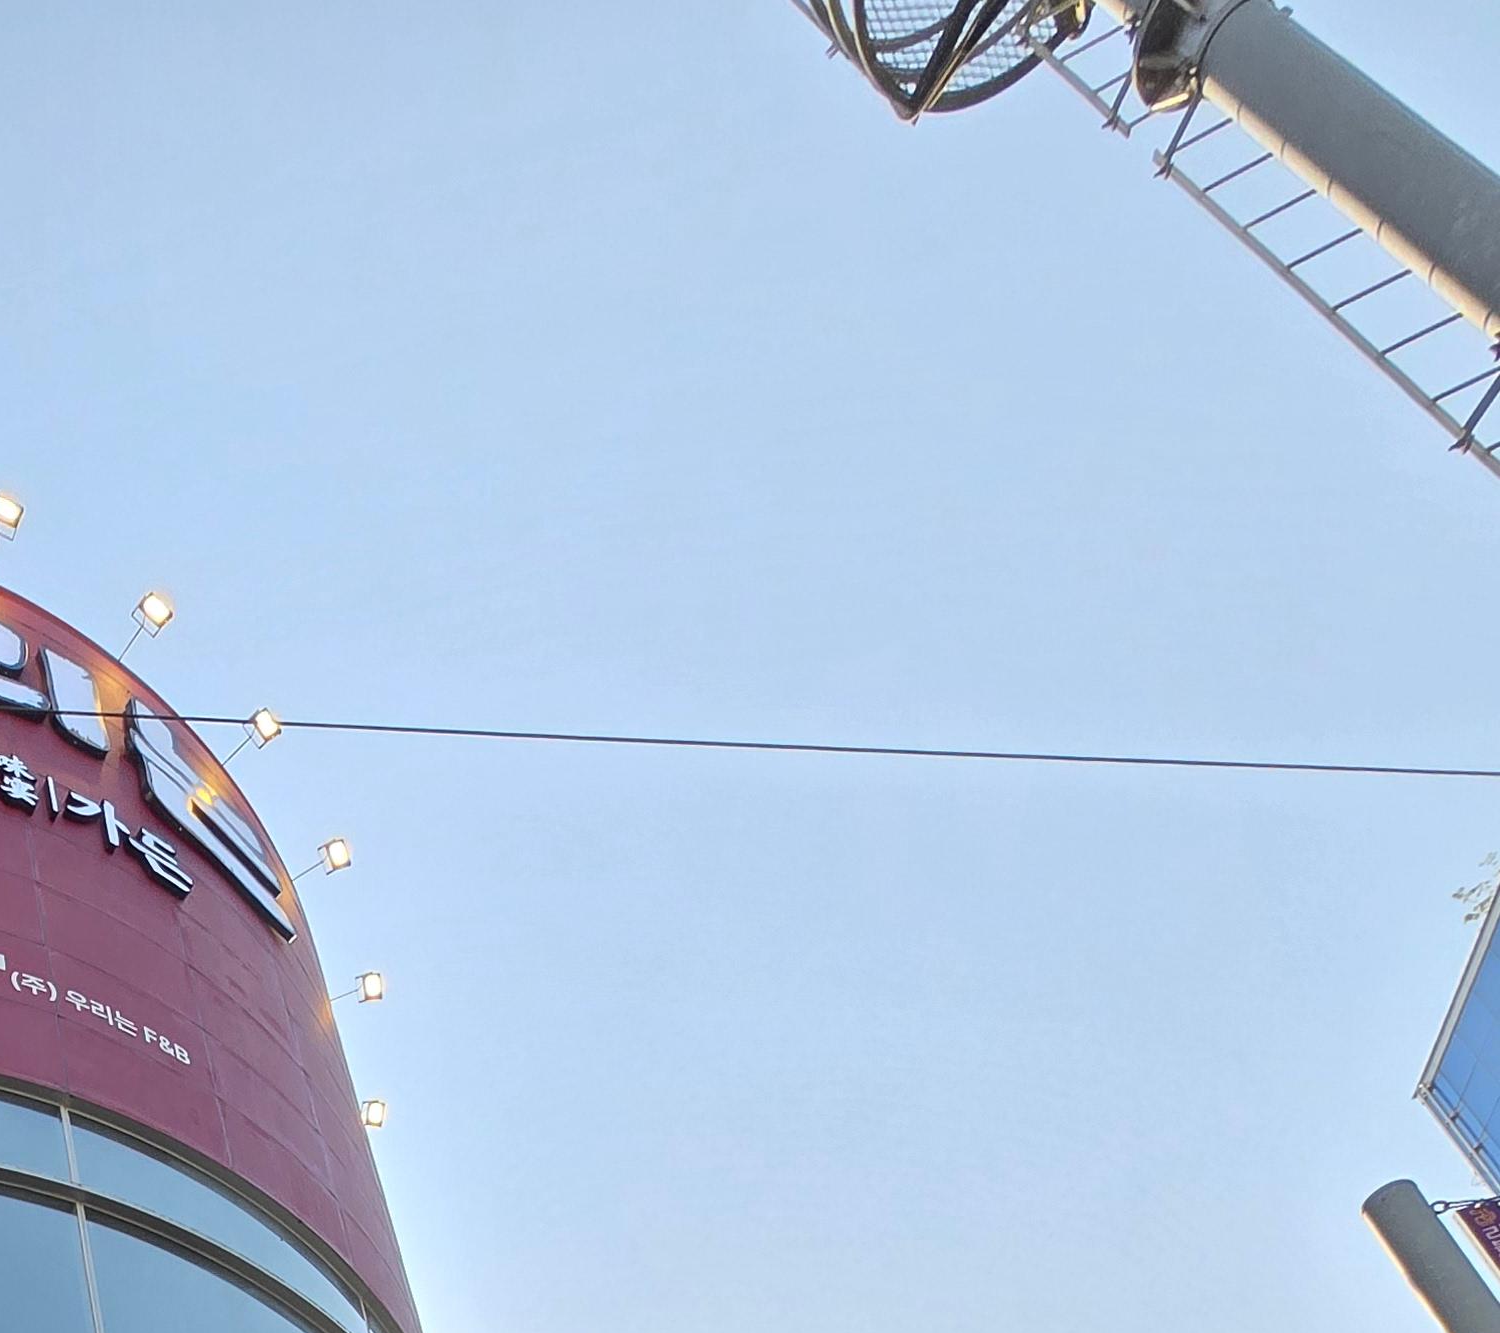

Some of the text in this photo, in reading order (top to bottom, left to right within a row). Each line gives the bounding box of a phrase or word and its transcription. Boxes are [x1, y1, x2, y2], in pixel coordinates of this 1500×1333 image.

[11, 971, 191, 1065] (주) 우리는 F&B
